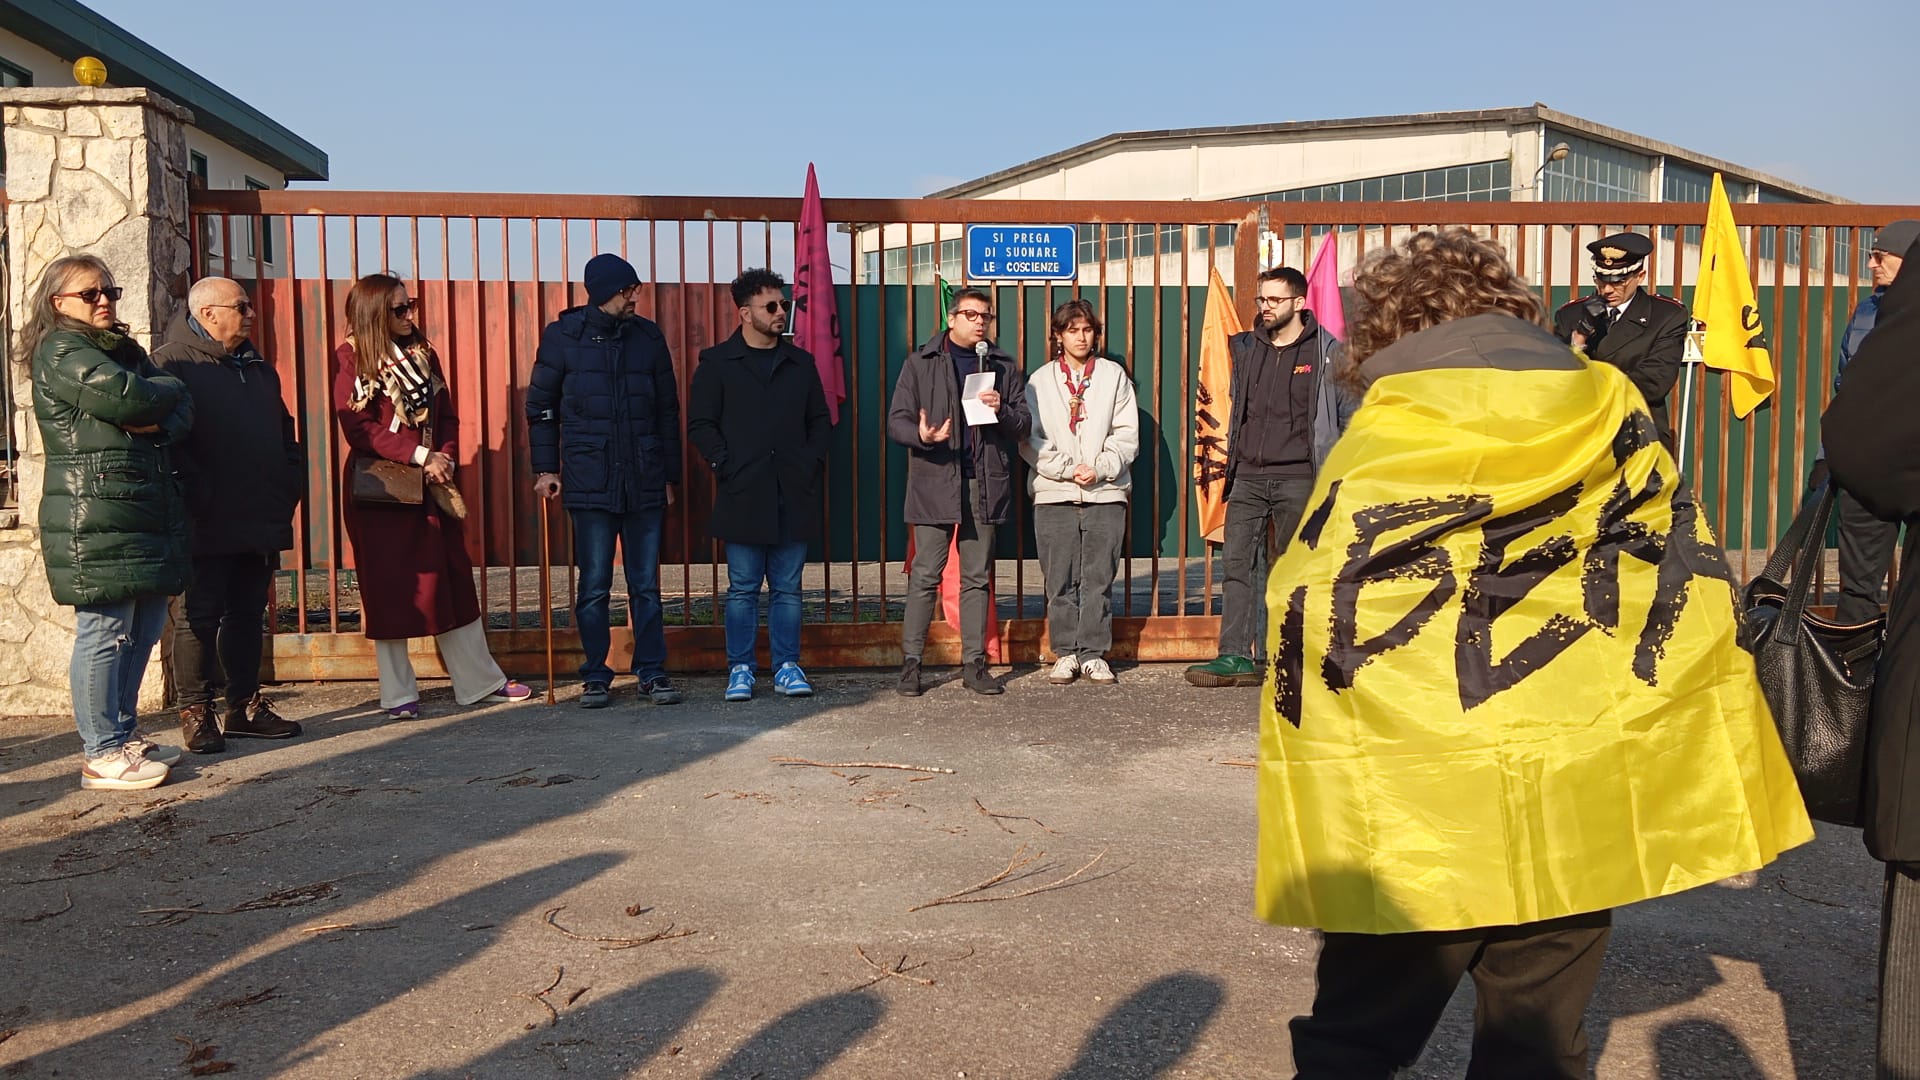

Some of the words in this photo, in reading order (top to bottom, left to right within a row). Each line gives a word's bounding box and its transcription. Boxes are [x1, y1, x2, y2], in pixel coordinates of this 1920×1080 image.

[993, 232, 1004, 243] SI
[1013, 232, 1050, 243] PREGA
[984, 247, 996, 258] DI
[1006, 247, 1058, 258] SUONARE
[983, 261, 996, 273] LE
[1006, 261, 1060, 273] COSCIENZE
